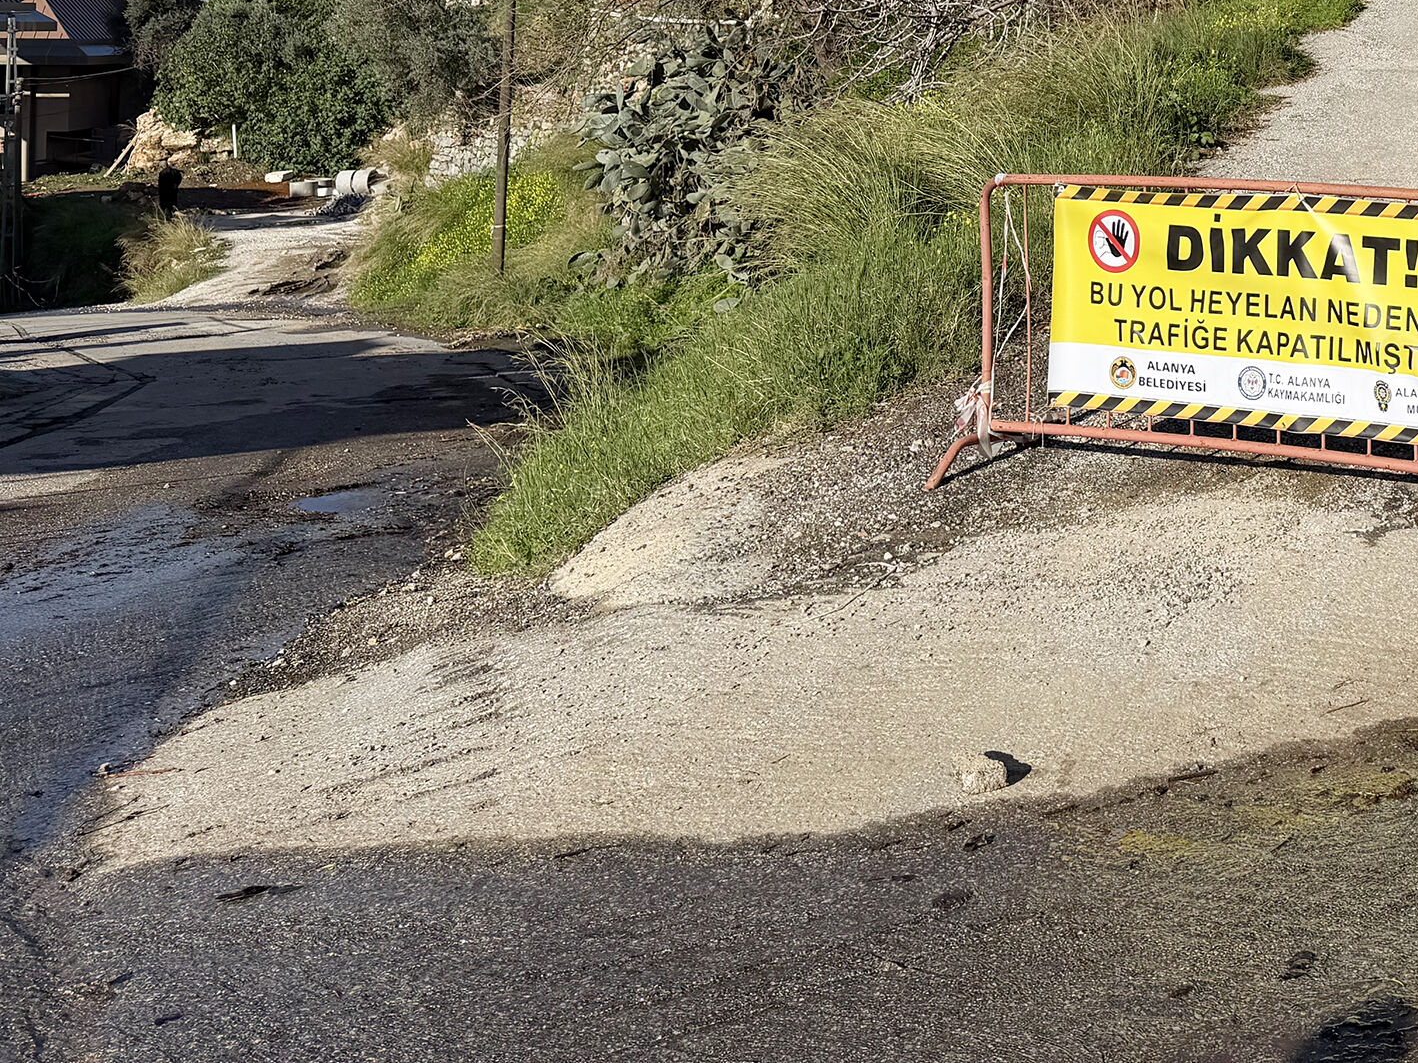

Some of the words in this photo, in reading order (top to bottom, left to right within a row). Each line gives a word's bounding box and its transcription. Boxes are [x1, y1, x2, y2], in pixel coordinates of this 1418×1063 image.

[1166, 213, 1418, 289] DİKKAT!
[1090, 281, 1123, 307] BU
[1131, 284, 1183, 312] YOL
[1190, 288, 1317, 322] HEYELAN
[1114, 318, 1228, 352] TRAFİĞE
[1147, 360, 1196, 375] ALANYA
[1138, 376, 1207, 393] BELEDİYESİ
[1268, 372, 1284, 385] T.C.
[1287, 375, 1331, 389] ALANYA
[1267, 387, 1346, 405] KAYMAKAMLIĞI
